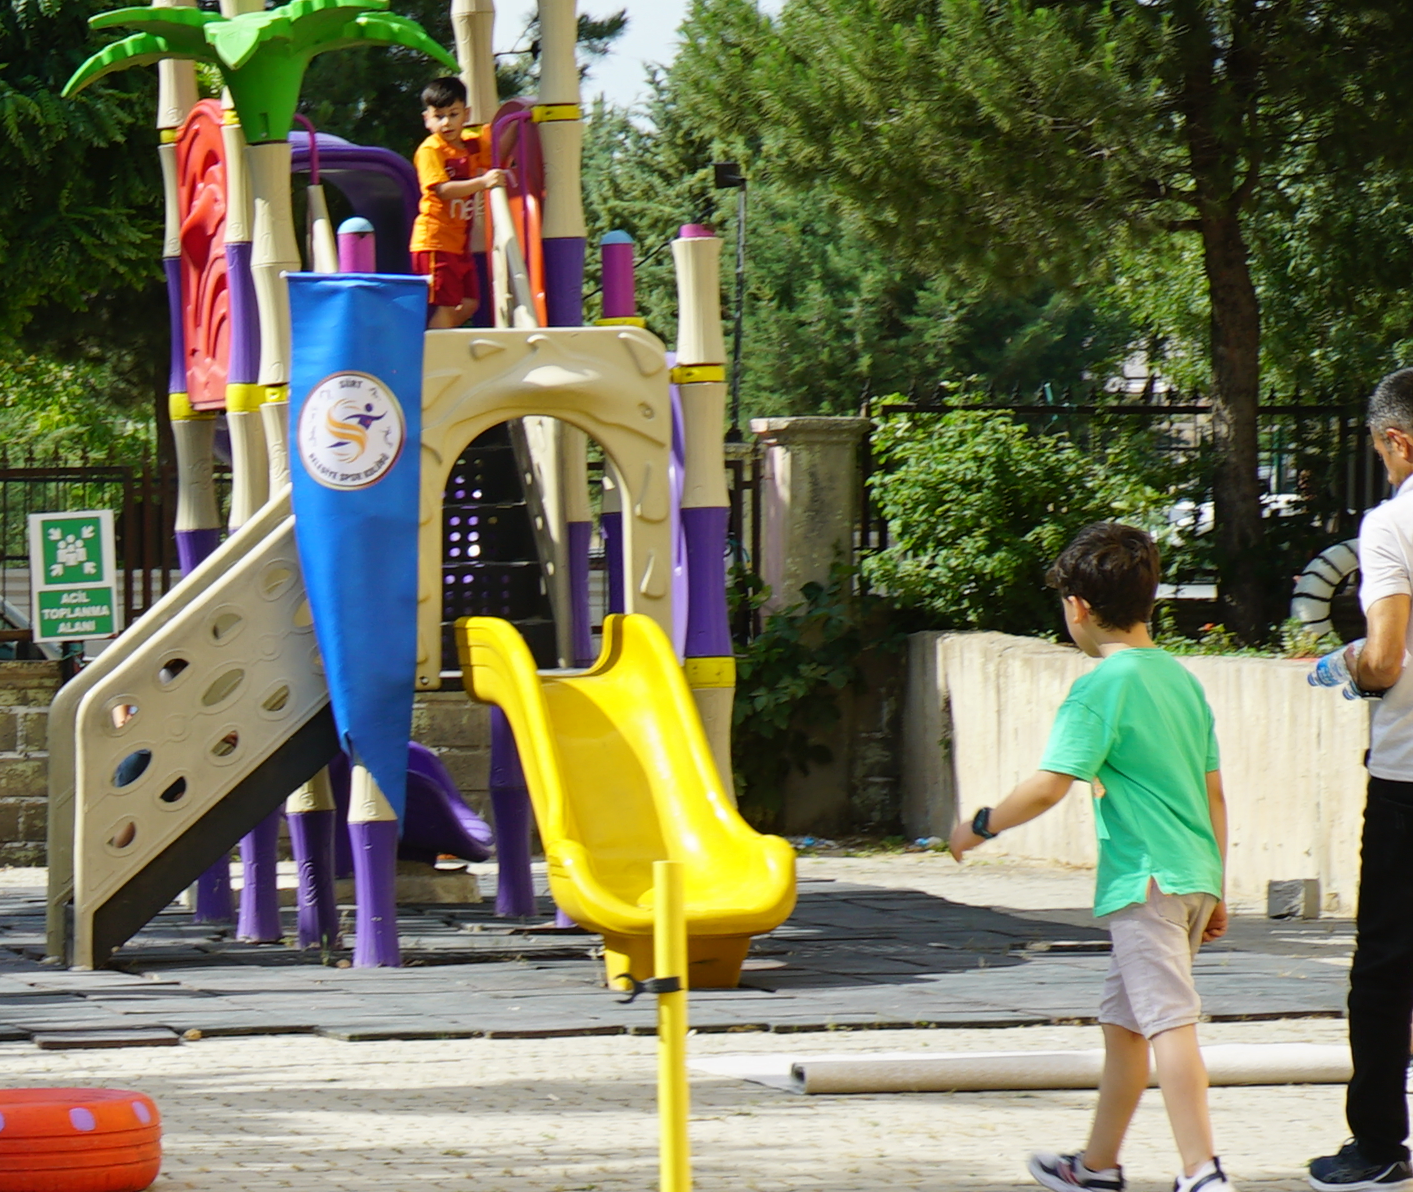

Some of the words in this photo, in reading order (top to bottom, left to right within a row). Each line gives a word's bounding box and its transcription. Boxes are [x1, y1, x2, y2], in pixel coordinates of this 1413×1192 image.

[60, 590, 91, 604] ACİL
[41, 605, 110, 620] TOPLANMA
[57, 620, 96, 633] ALANI
